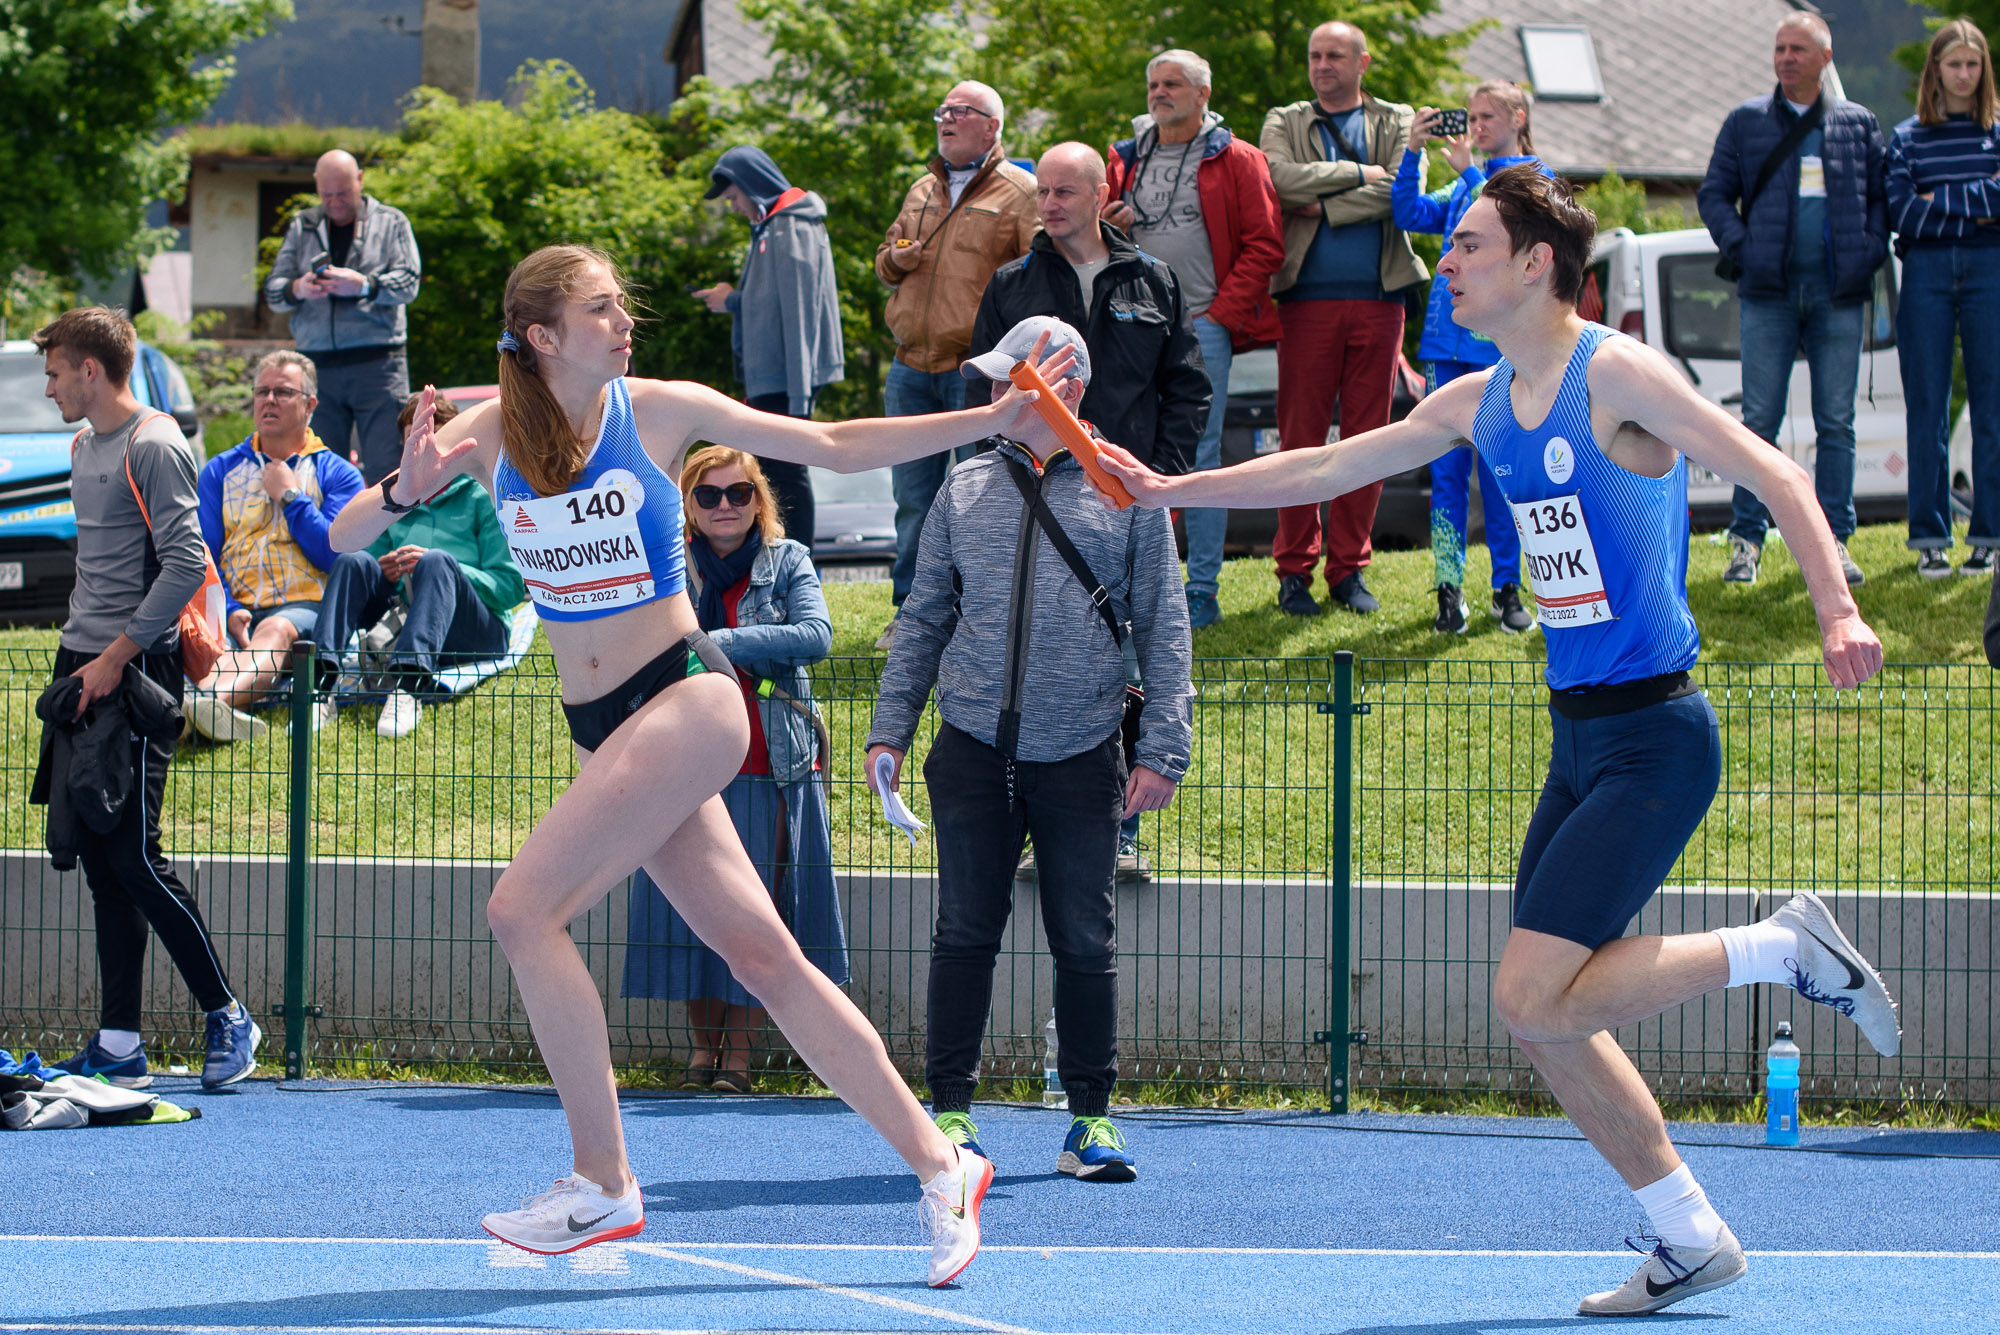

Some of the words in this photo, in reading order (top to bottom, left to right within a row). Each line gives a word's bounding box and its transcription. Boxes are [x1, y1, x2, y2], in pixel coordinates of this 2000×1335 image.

[566, 490, 626, 525] 140
[1529, 502, 1577, 535] 136
[511, 535, 639, 573] TWARDOWSKA
[590, 589, 619, 603] 2022
[1556, 608, 1578, 620] 2022
